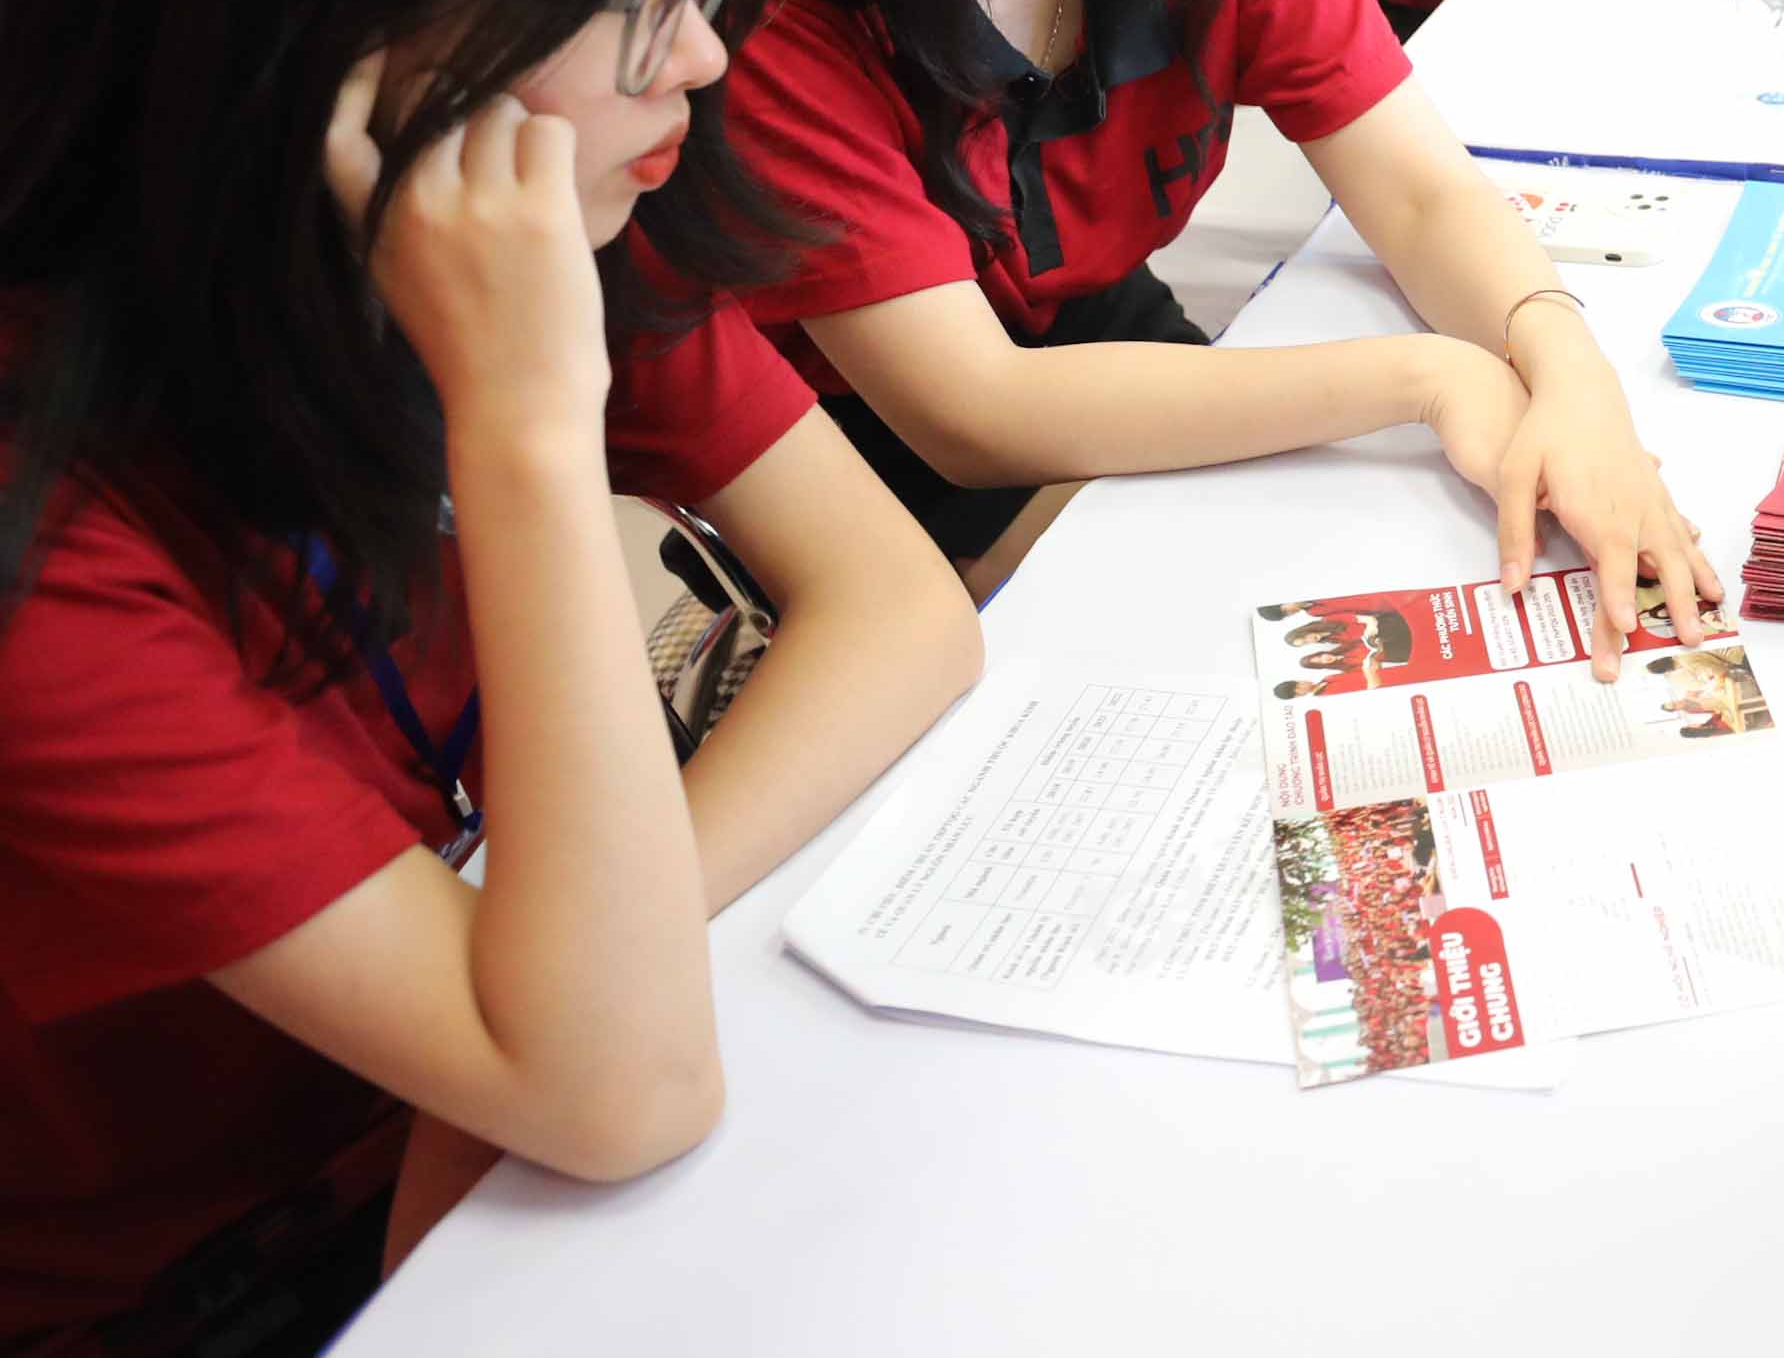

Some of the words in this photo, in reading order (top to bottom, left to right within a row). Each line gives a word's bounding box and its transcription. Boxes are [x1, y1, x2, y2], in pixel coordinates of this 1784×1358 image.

[1444, 608, 1460, 631] TUYỂN
[1438, 643, 1454, 659] CÁC
[1439, 932, 1473, 994] THIỆU
[1449, 996, 1482, 1047] GIỚI
[1478, 962, 1514, 1042] CHUNG
